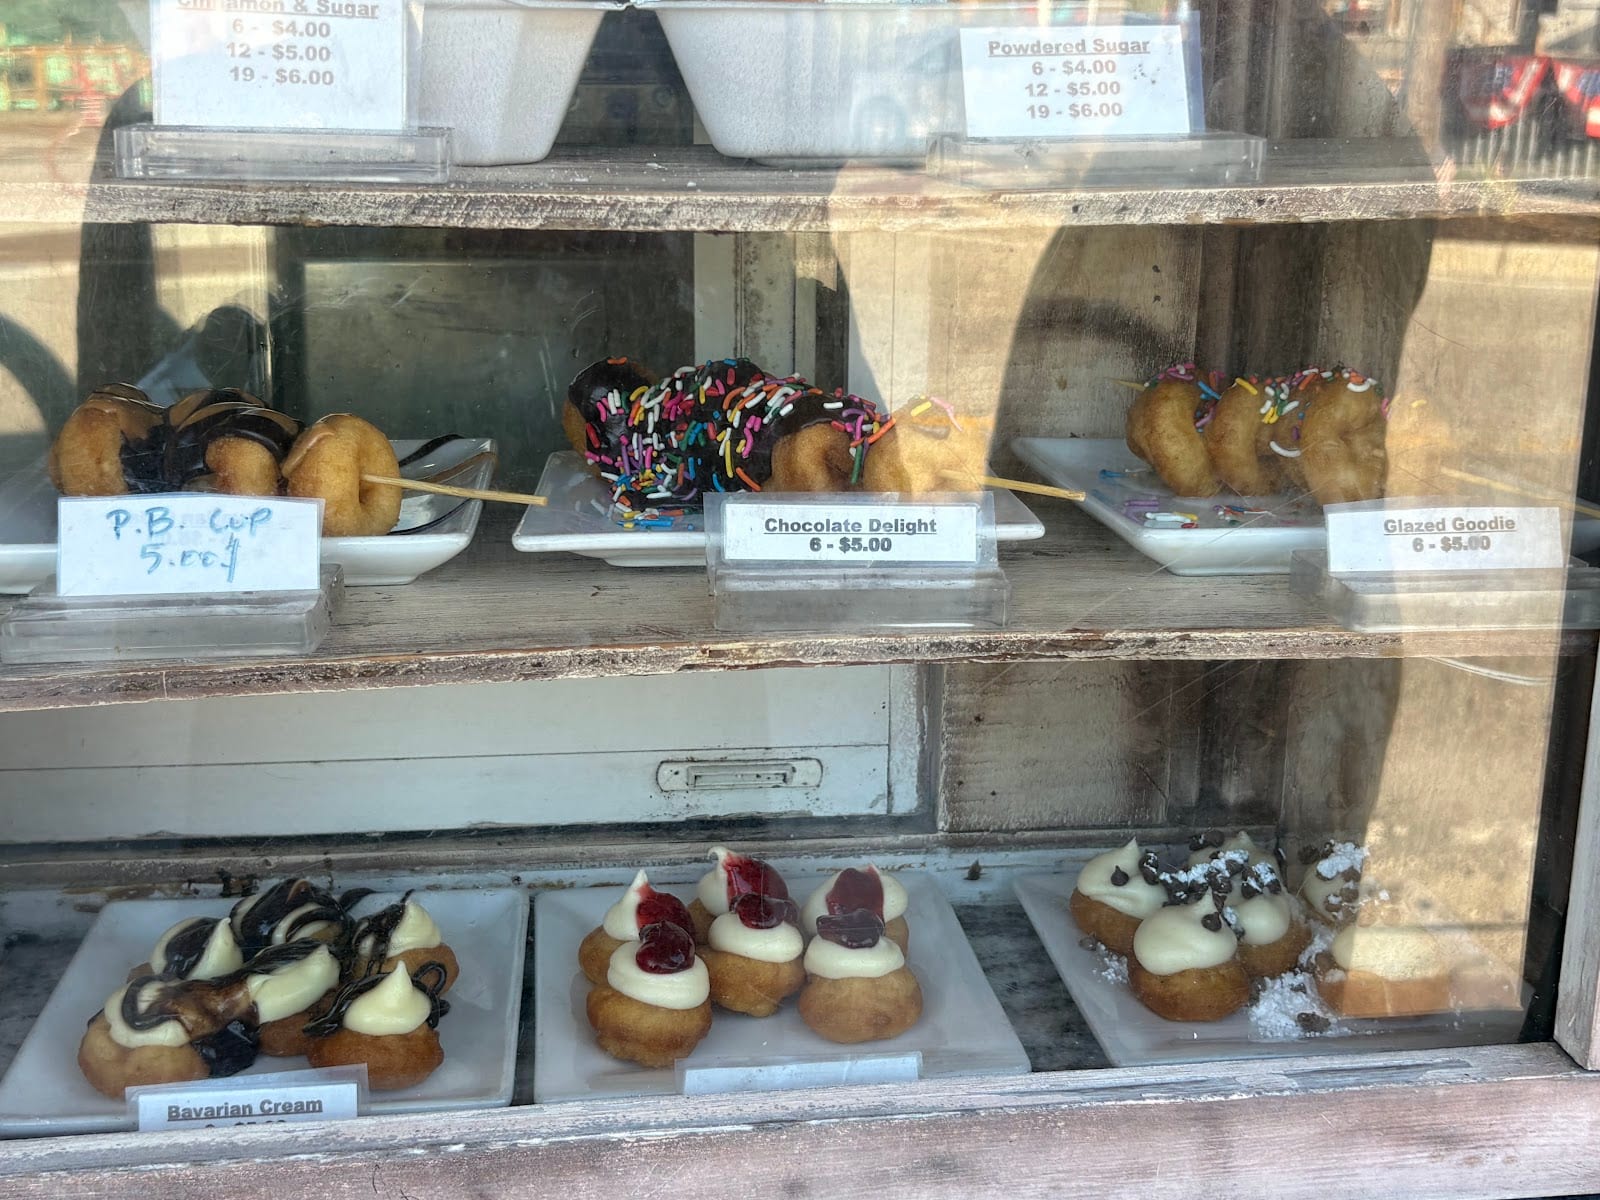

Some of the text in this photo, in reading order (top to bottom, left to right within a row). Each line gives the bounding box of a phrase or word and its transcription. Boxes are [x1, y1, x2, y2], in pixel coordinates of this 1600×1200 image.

[294, 0, 308, 13] &
[317, 0, 379, 17] Sugar
[232, 18, 243, 35] 6
[272, 19, 331, 38] $4.00
[227, 42, 251, 58] 12
[272, 44, 331, 62] $5.00
[988, 38, 1150, 56] Powdered Sugar
[229, 66, 255, 82] 19
[275, 67, 334, 86] $6.00
[1031, 61, 1043, 76] 6
[1062, 59, 1116, 76] $4.00
[1025, 82, 1048, 97] 12
[1067, 81, 1121, 97] $5.00
[1027, 104, 1050, 119] 19
[1069, 102, 1123, 119] $6.00
[764, 518, 937, 536] Chocolate Delight
[1384, 516, 1516, 534] Glazed Goodie
[810, 537, 822, 552] 6
[838, 536, 892, 553] $5.00
[1412, 537, 1424, 553] 6
[1440, 536, 1491, 553] $5.00
[167, 1099, 323, 1119] Bavarian Cream
